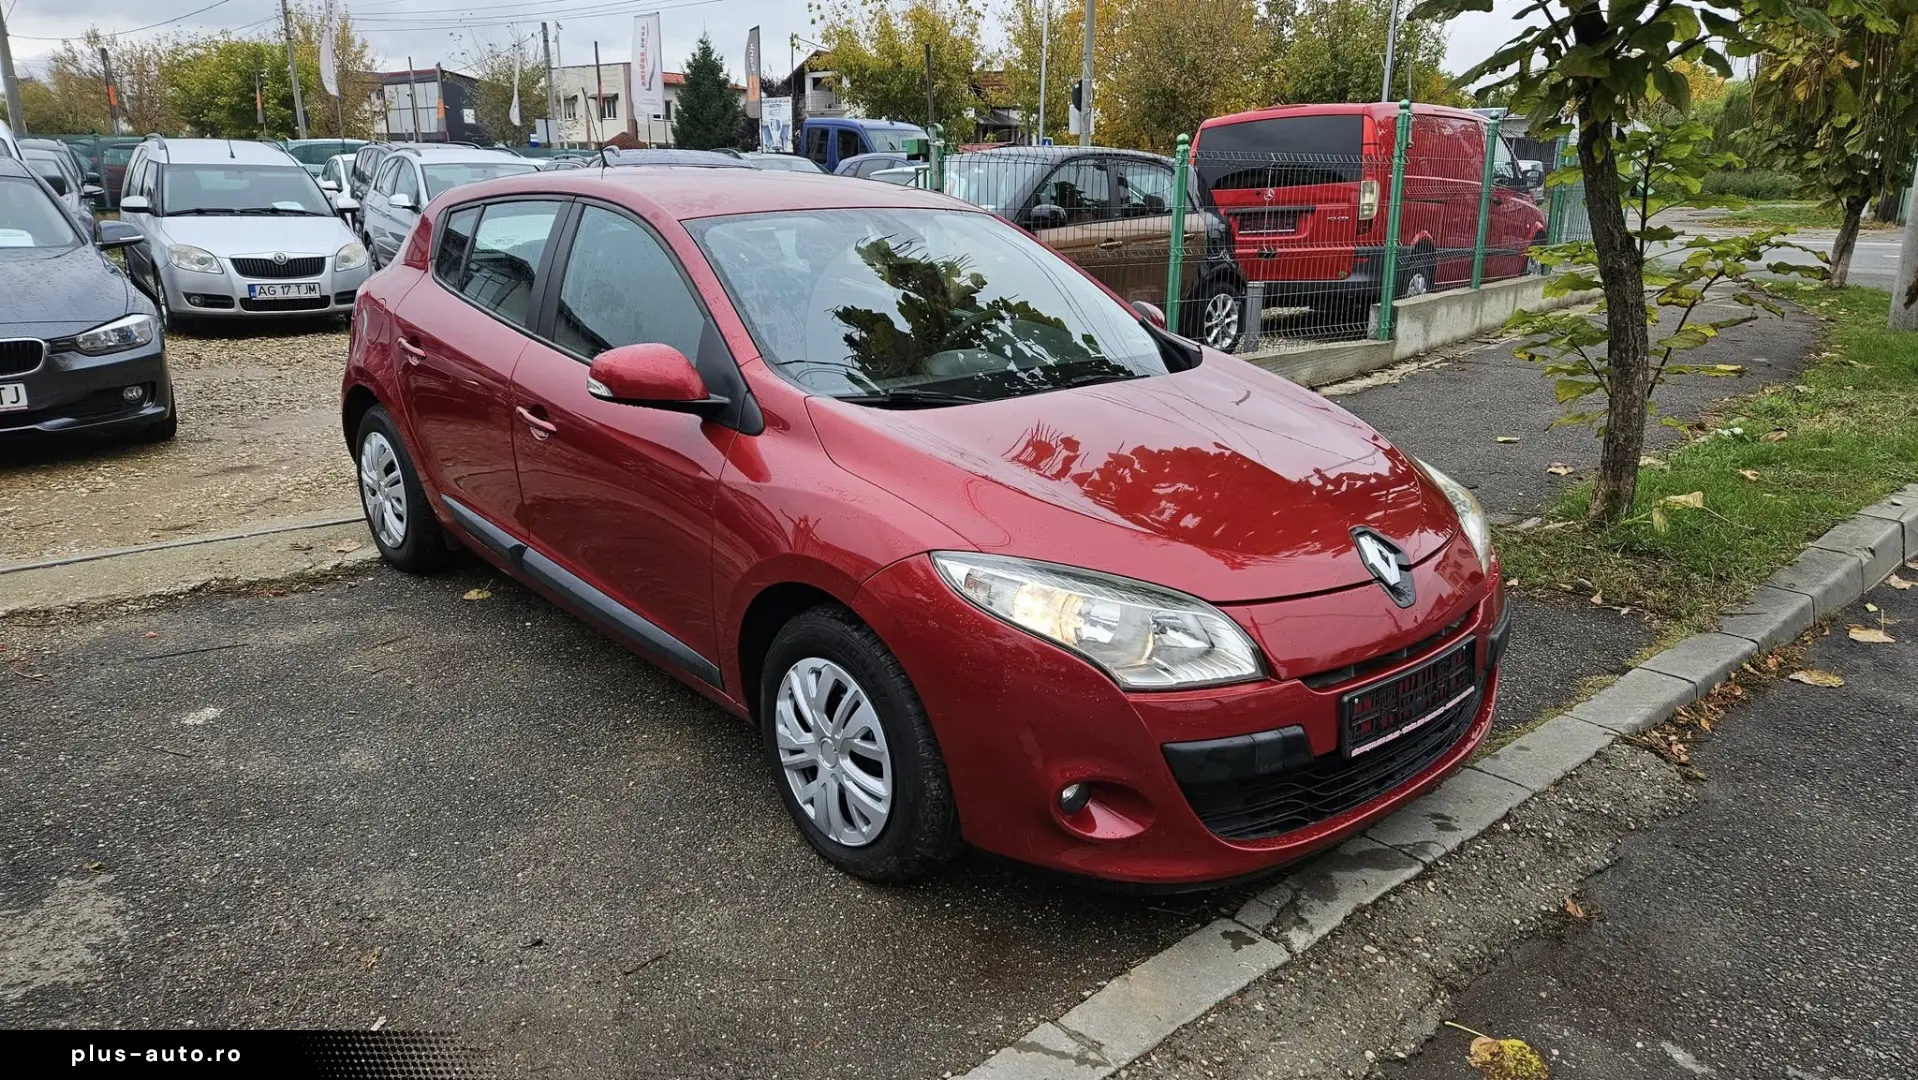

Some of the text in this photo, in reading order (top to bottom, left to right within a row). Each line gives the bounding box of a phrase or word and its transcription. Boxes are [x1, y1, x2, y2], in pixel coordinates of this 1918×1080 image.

[258, 284, 317, 296] AG 17 TJM
